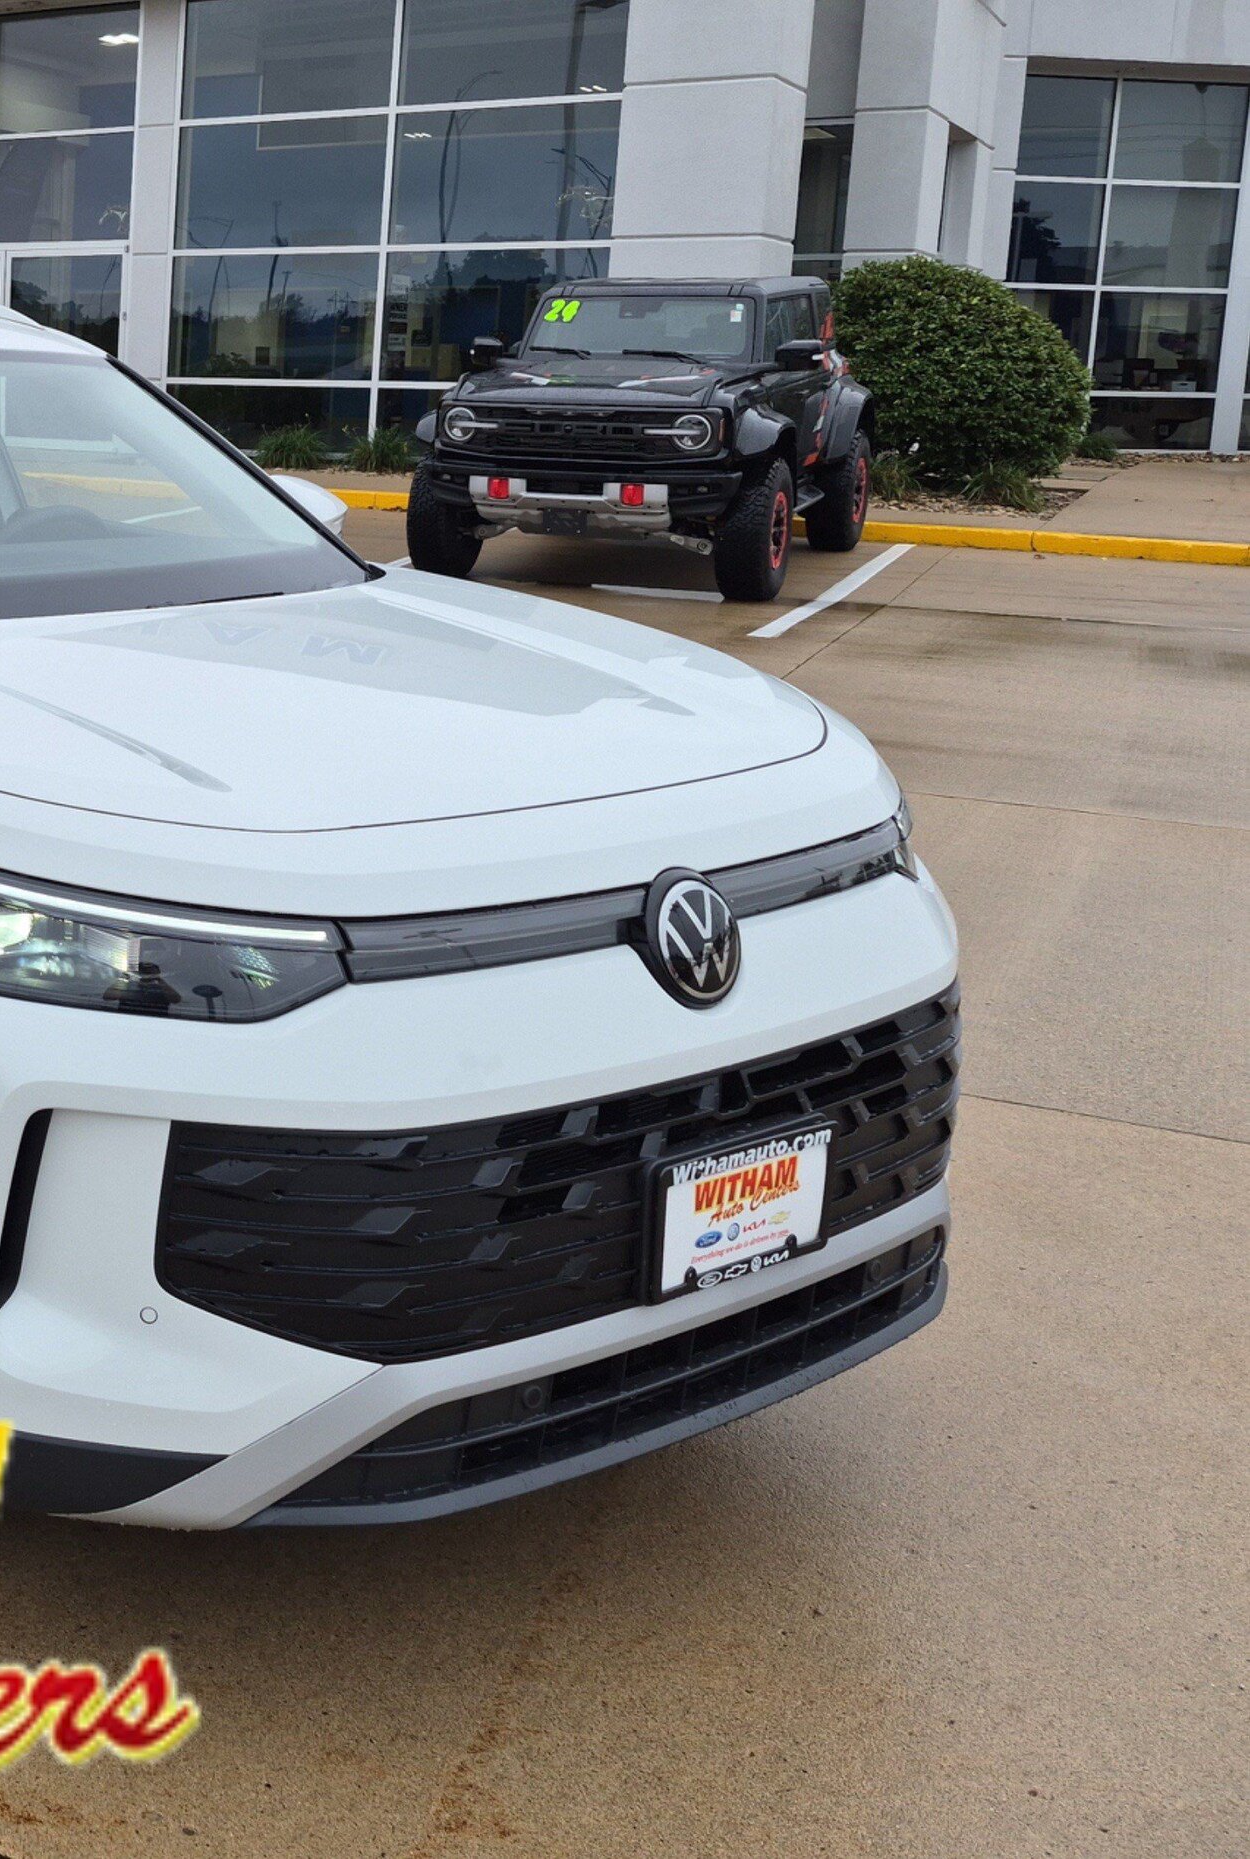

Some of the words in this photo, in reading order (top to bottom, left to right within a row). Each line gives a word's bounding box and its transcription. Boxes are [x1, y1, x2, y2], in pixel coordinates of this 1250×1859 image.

[544, 299, 581, 322] 24
[694, 1154, 800, 1213] WITHAM
[708, 1202, 744, 1227] Auto
[749, 1180, 801, 1212] Centers
